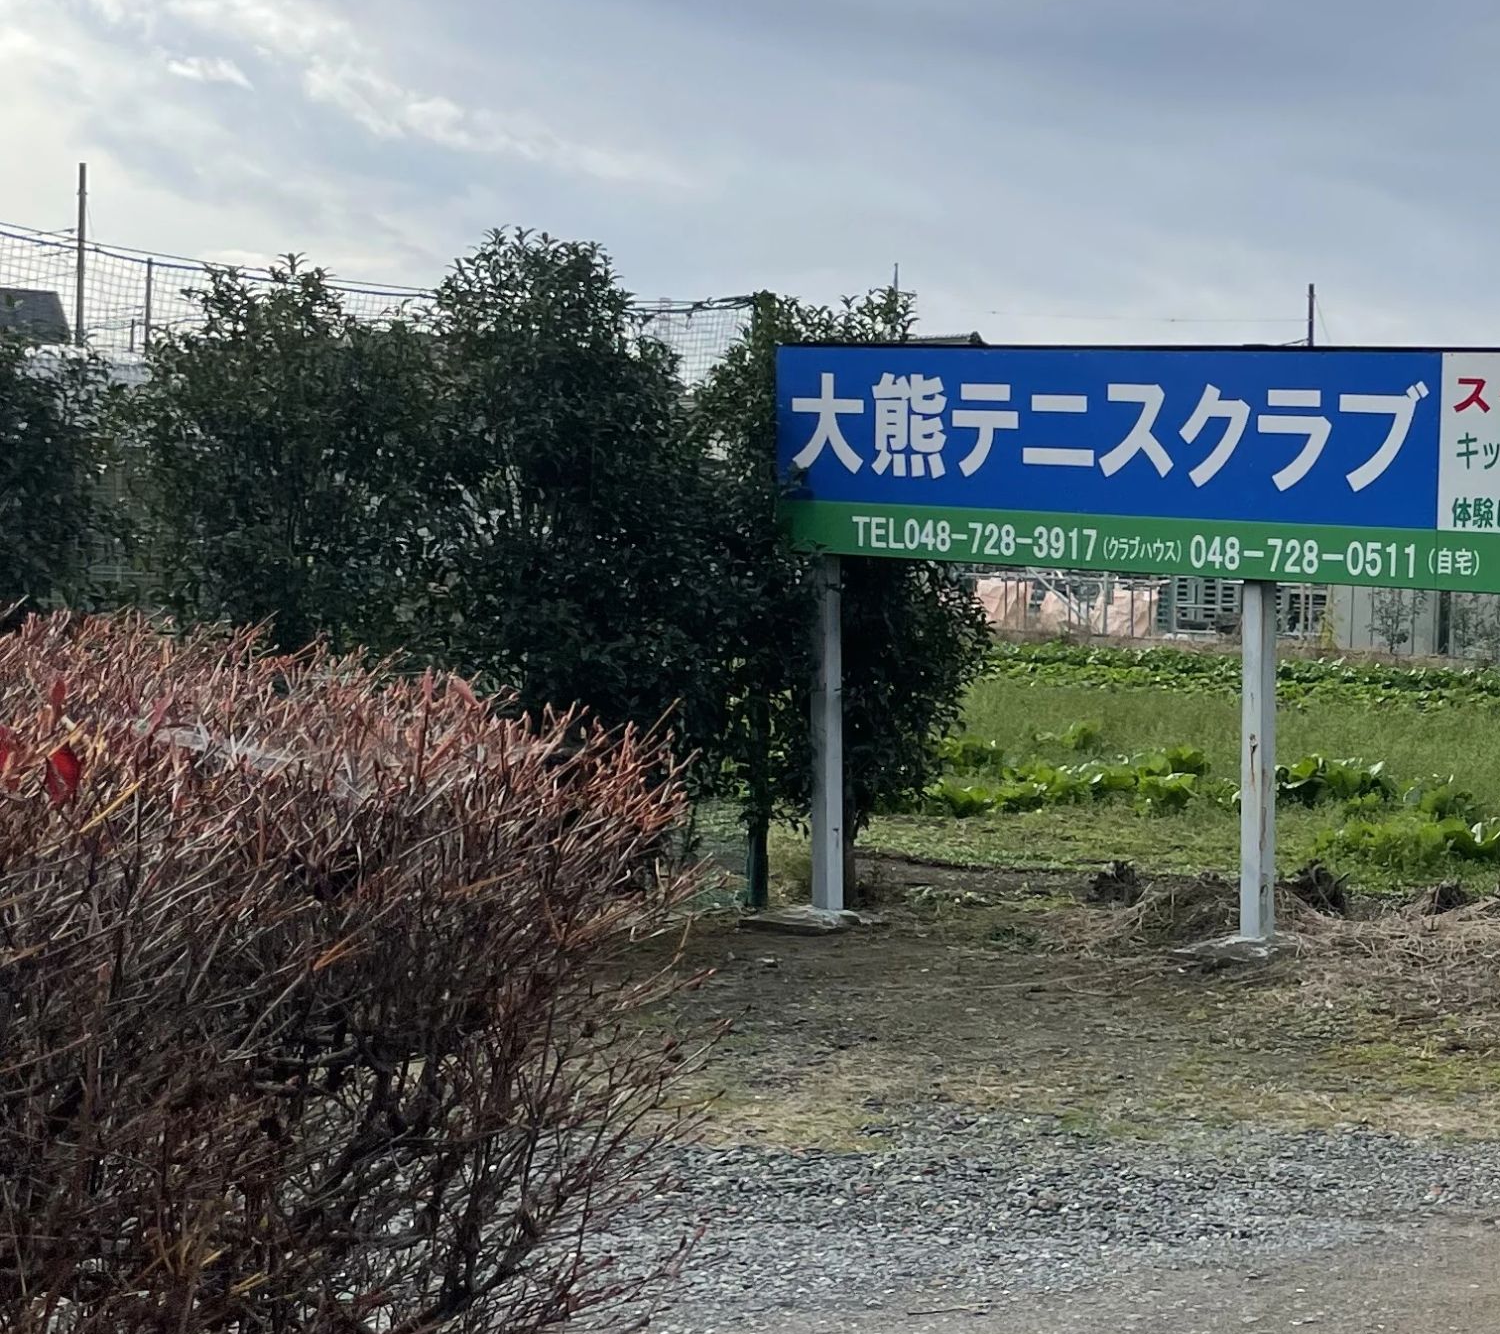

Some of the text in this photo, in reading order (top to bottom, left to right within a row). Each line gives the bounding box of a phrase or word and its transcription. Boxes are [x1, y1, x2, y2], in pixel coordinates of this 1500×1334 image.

[790, 371, 1429, 492] 大熊テニスクラブ
